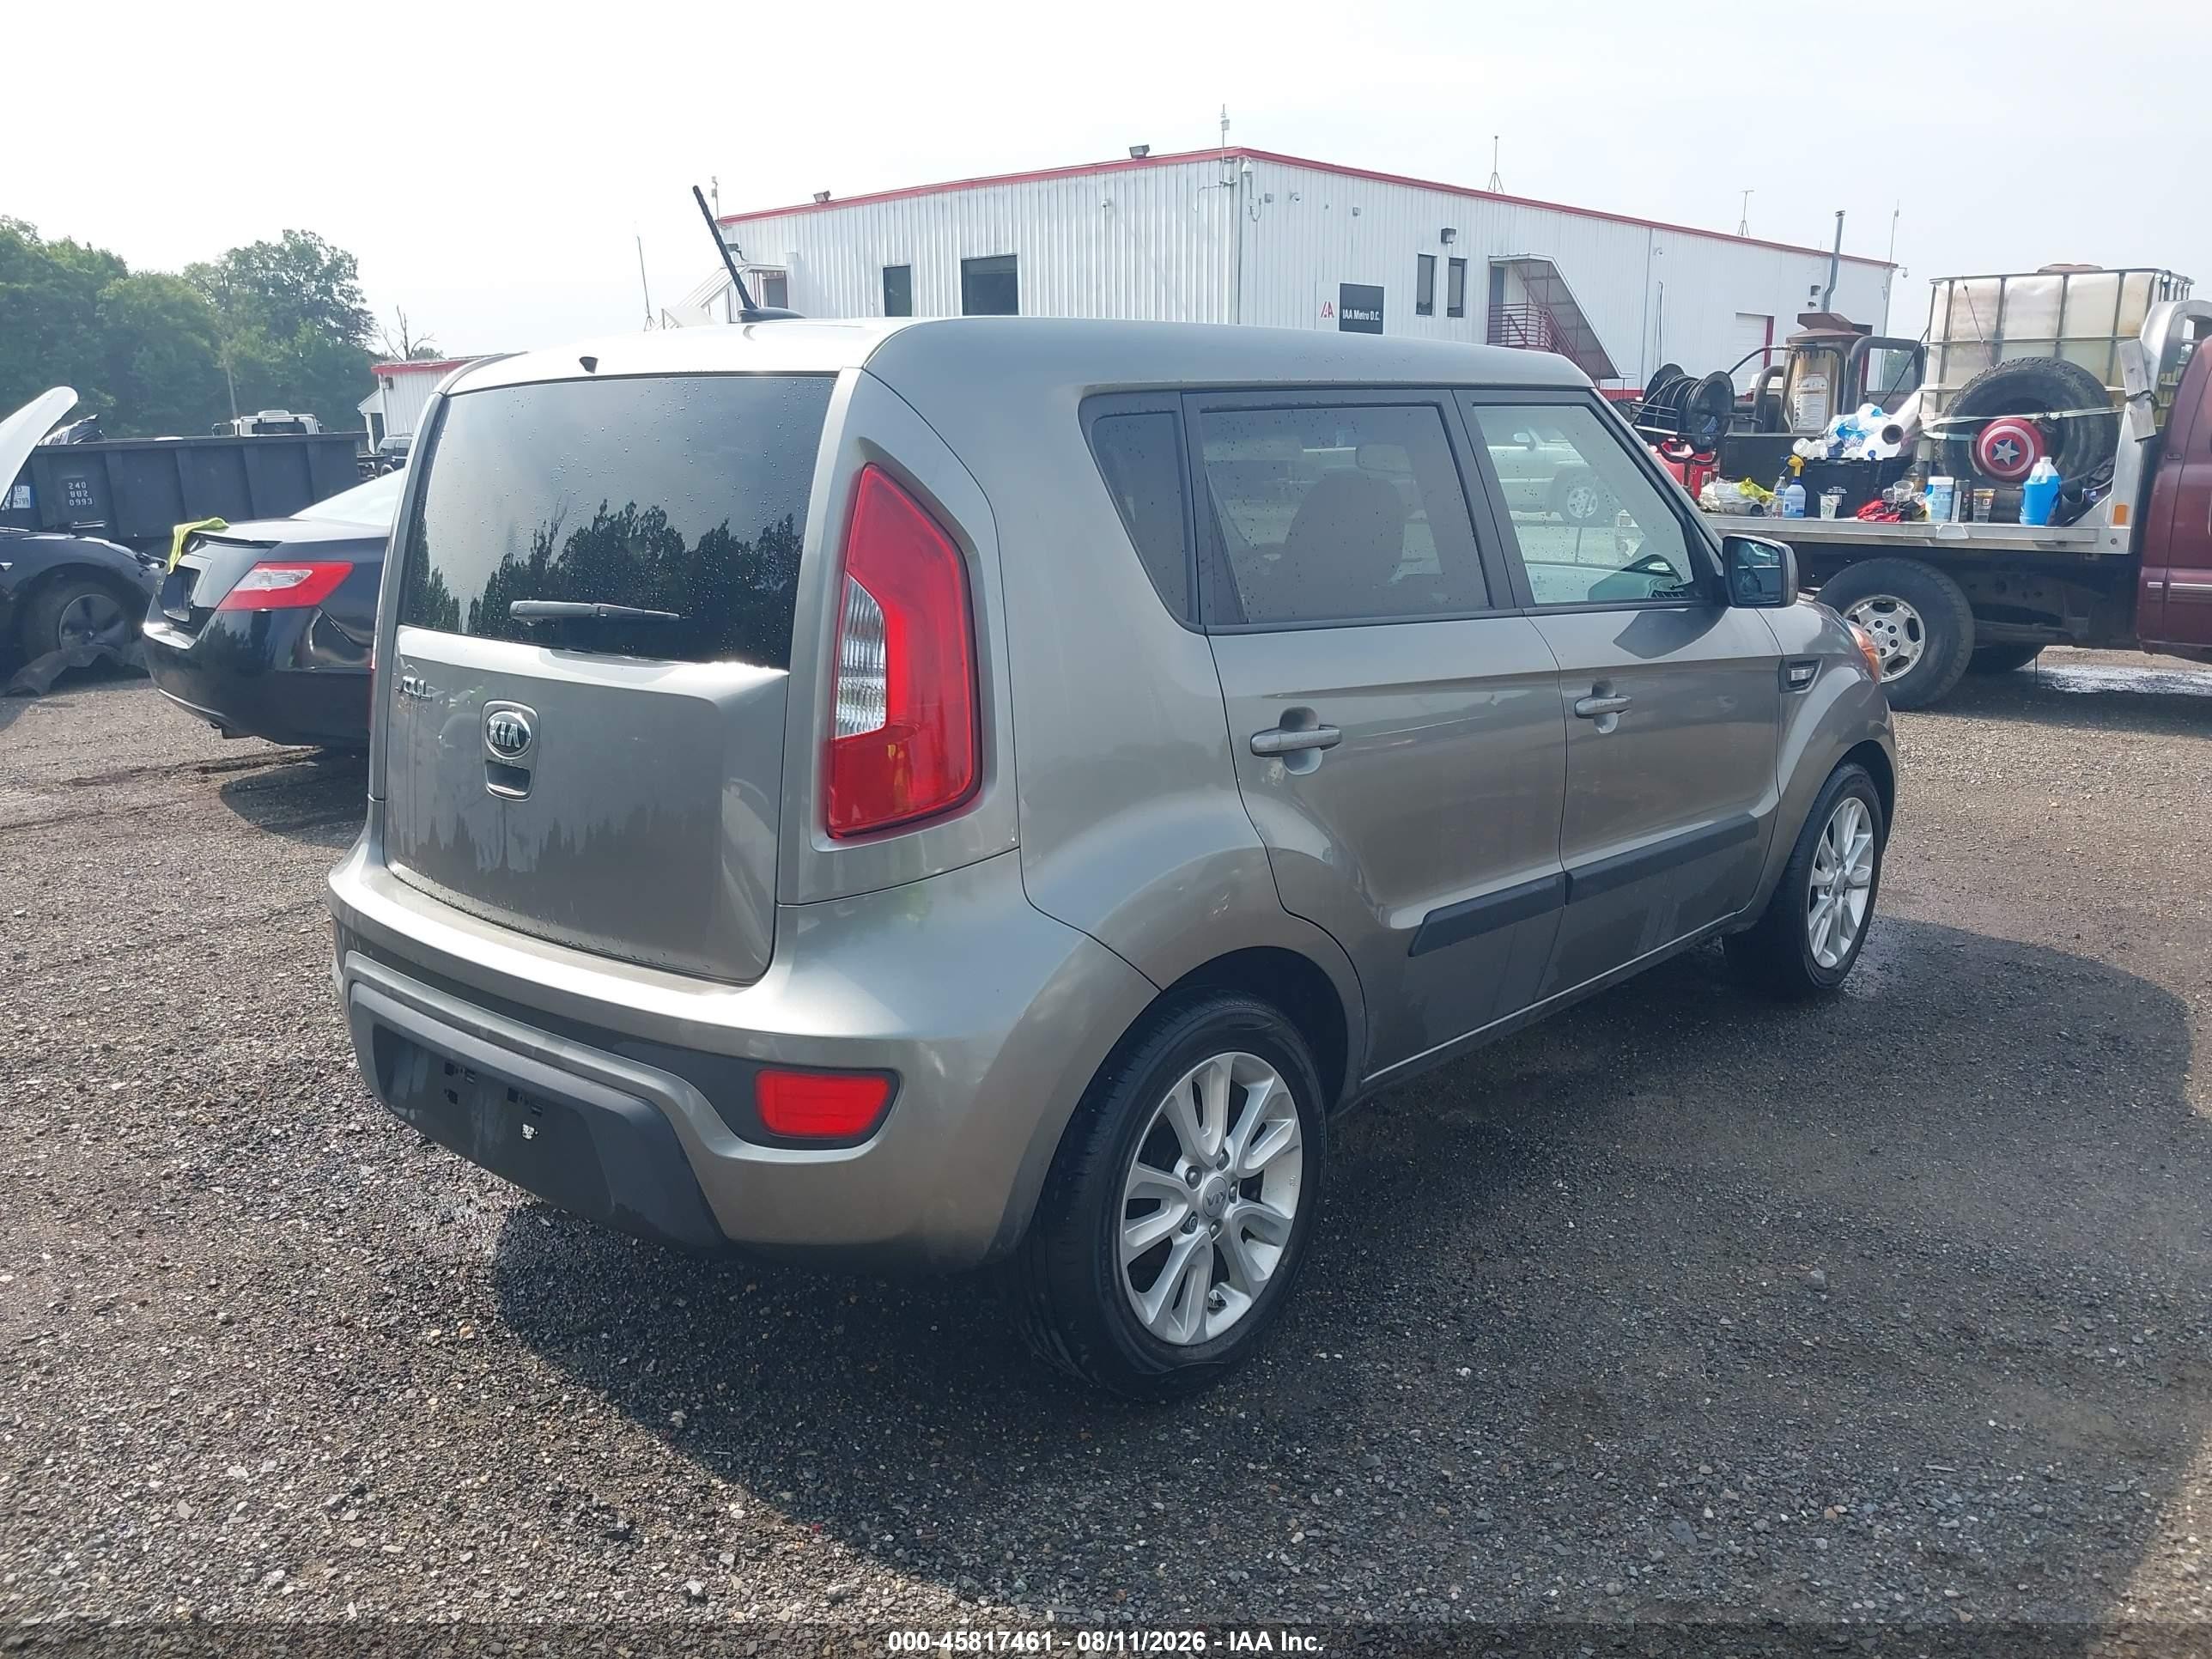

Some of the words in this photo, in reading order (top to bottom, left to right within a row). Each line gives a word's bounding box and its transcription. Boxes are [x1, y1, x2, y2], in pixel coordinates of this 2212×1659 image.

[1342, 309, 1352, 319] IAA
[1353, 310, 1370, 321] Metro
[1370, 310, 1381, 321] D.C.
[69, 481, 87, 489] 240
[69, 498, 93, 507] 0993
[489, 720, 520, 748] KIA
